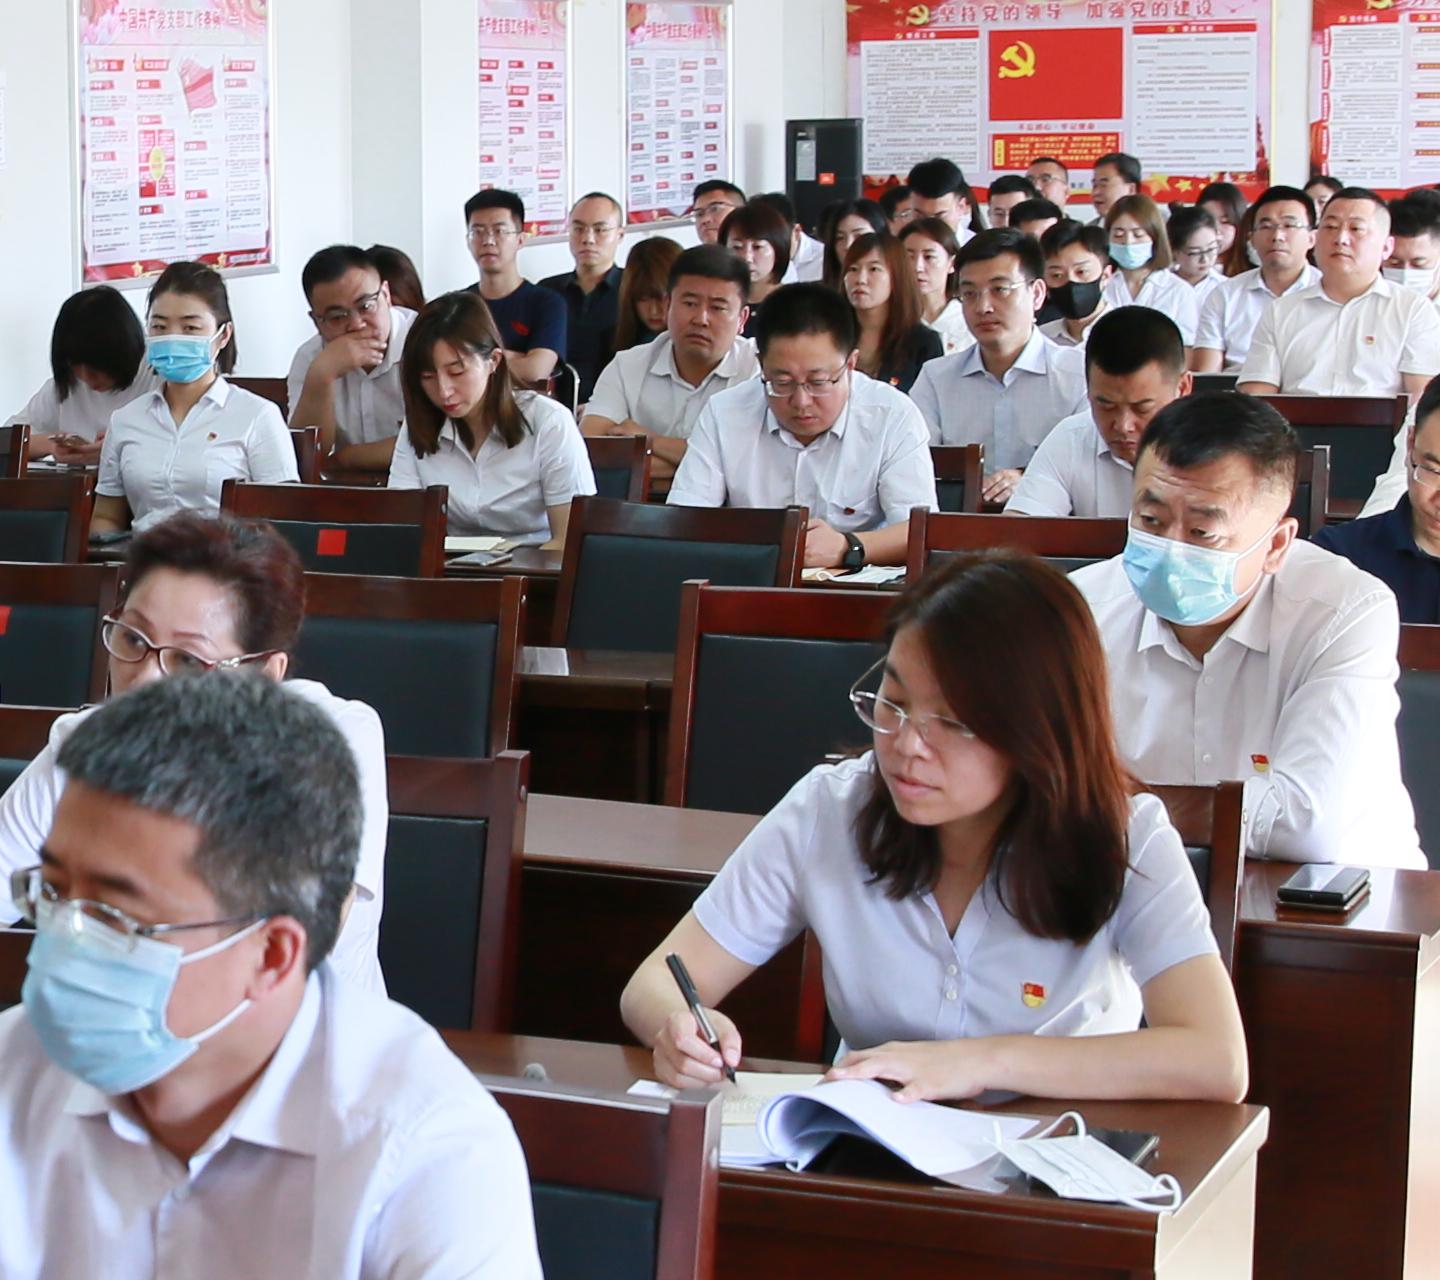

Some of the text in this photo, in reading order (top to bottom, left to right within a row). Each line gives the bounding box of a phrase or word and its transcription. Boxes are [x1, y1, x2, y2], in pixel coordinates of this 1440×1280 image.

[1086, 0, 1213, 19] 加强党的建设
